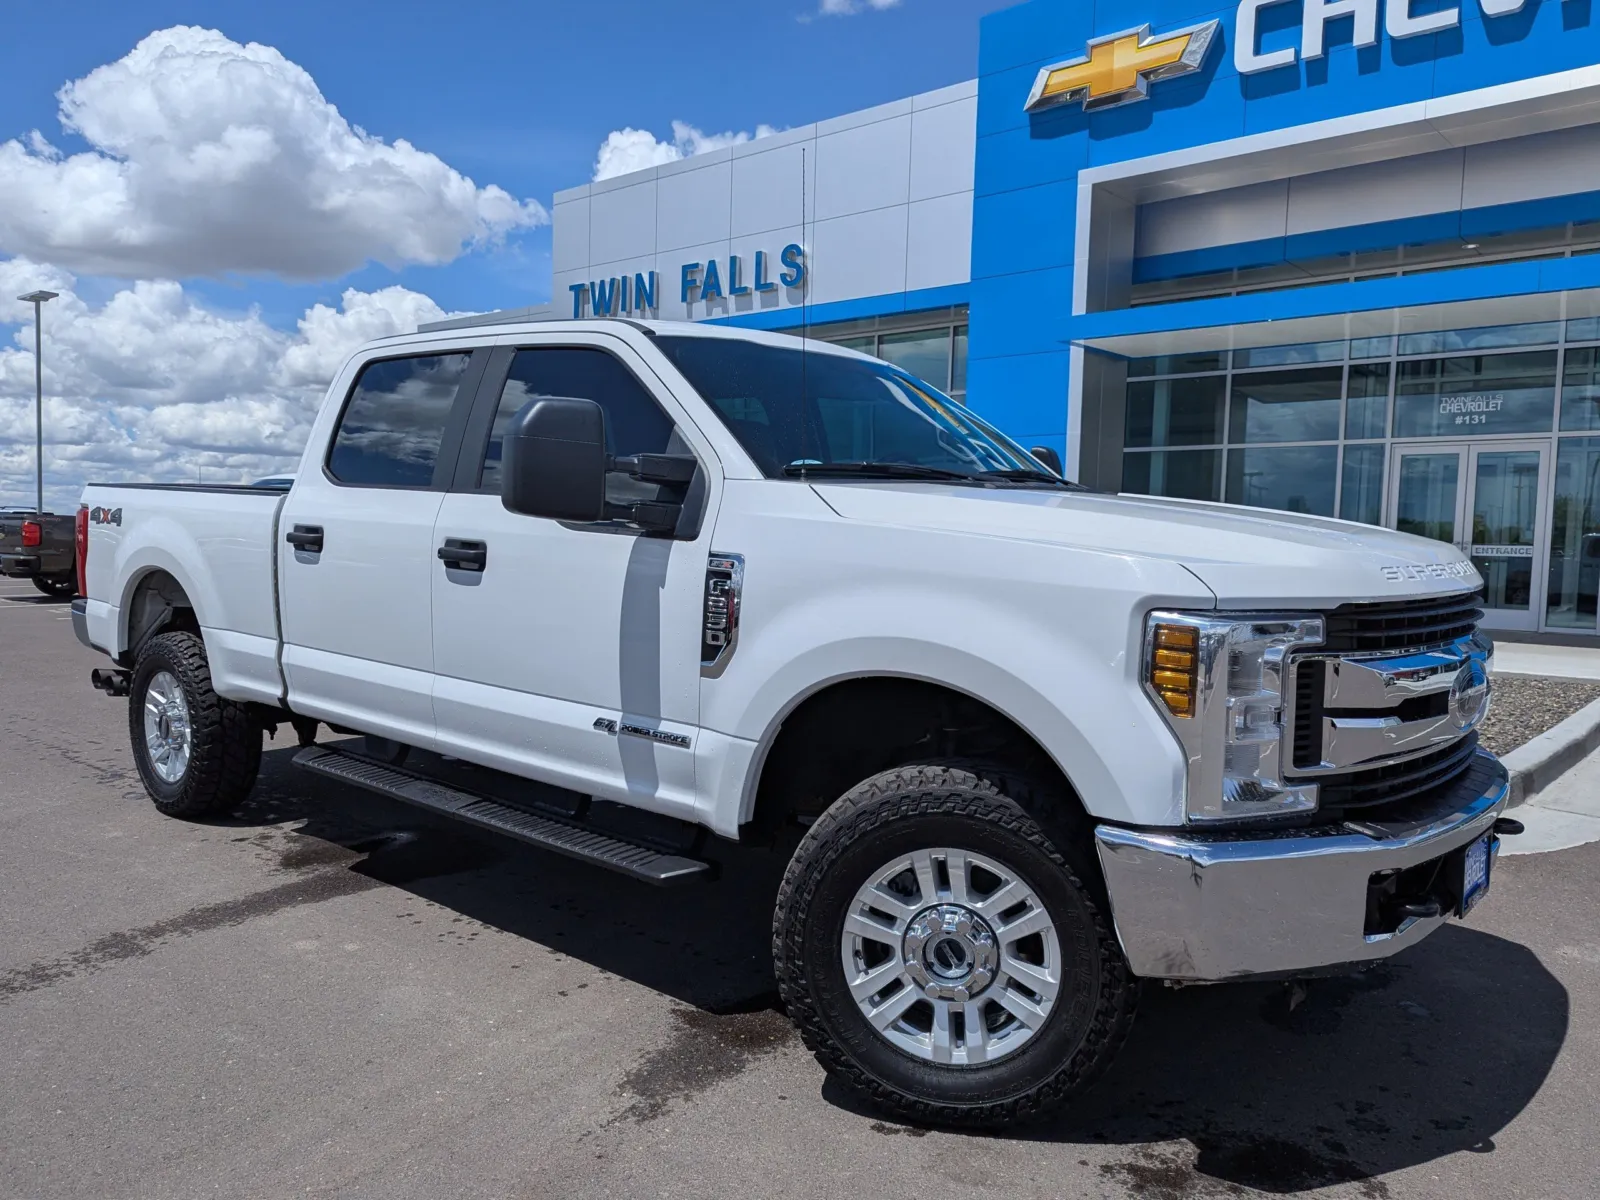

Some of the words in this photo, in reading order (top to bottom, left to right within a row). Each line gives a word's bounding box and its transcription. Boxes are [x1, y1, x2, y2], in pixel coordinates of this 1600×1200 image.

[569, 271, 657, 319] TWIN
[681, 244, 807, 303] FALLS
[1440, 400, 1503, 413] CHEVROLET
[1455, 414, 1486, 425] #131
[1475, 547, 1532, 555] ENTRANCE
[651, 731, 688, 743] STROKE
